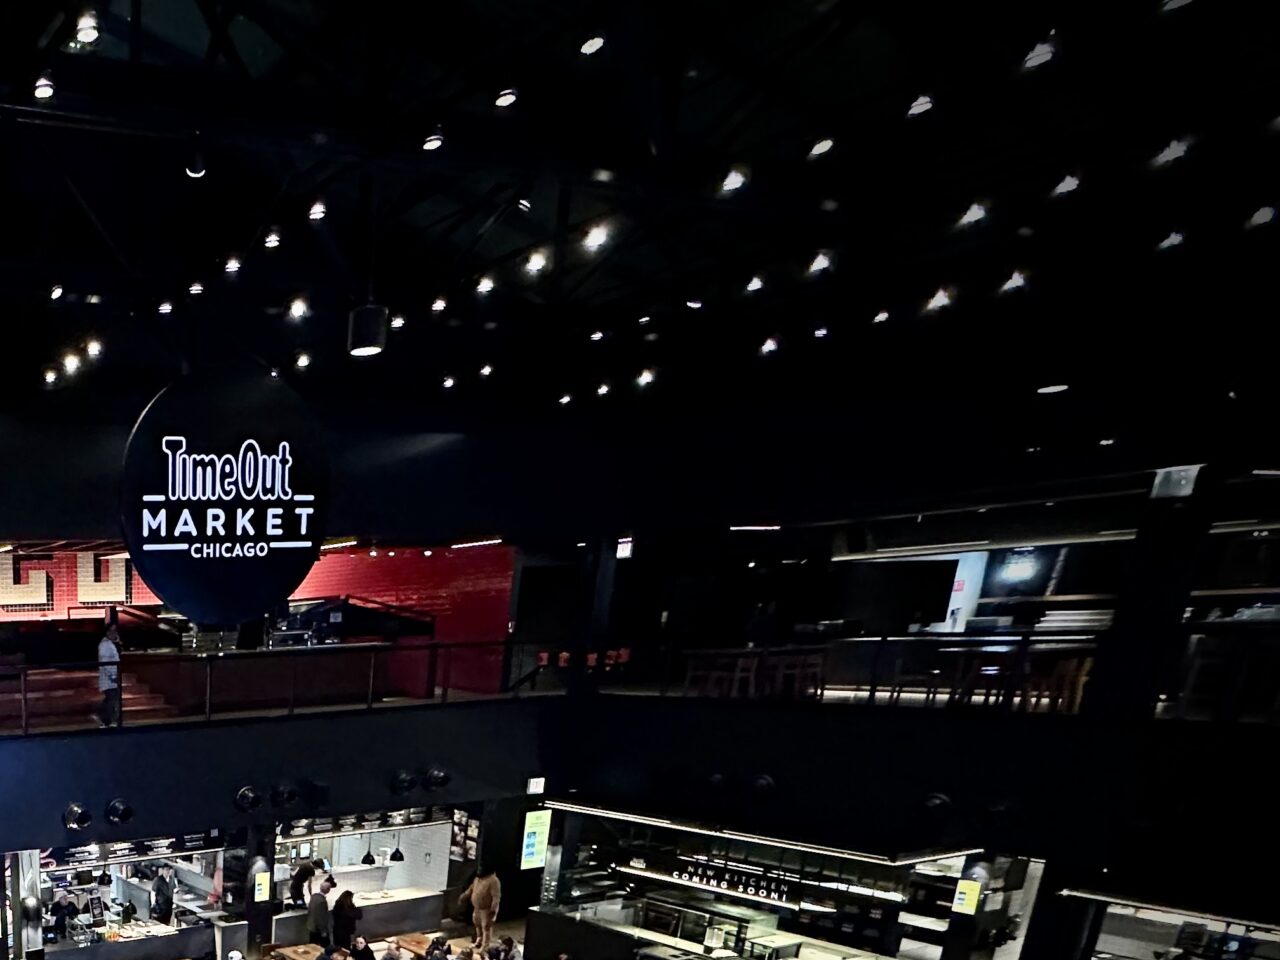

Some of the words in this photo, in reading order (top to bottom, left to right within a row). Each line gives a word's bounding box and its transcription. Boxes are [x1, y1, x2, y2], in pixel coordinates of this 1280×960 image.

[142, 508, 314, 537] MARKET
[190, 543, 269, 558] CHICAGO
[672, 871, 728, 889] COMING
[687, 866, 715, 877] NEW
[724, 873, 788, 892] KITCHEN
